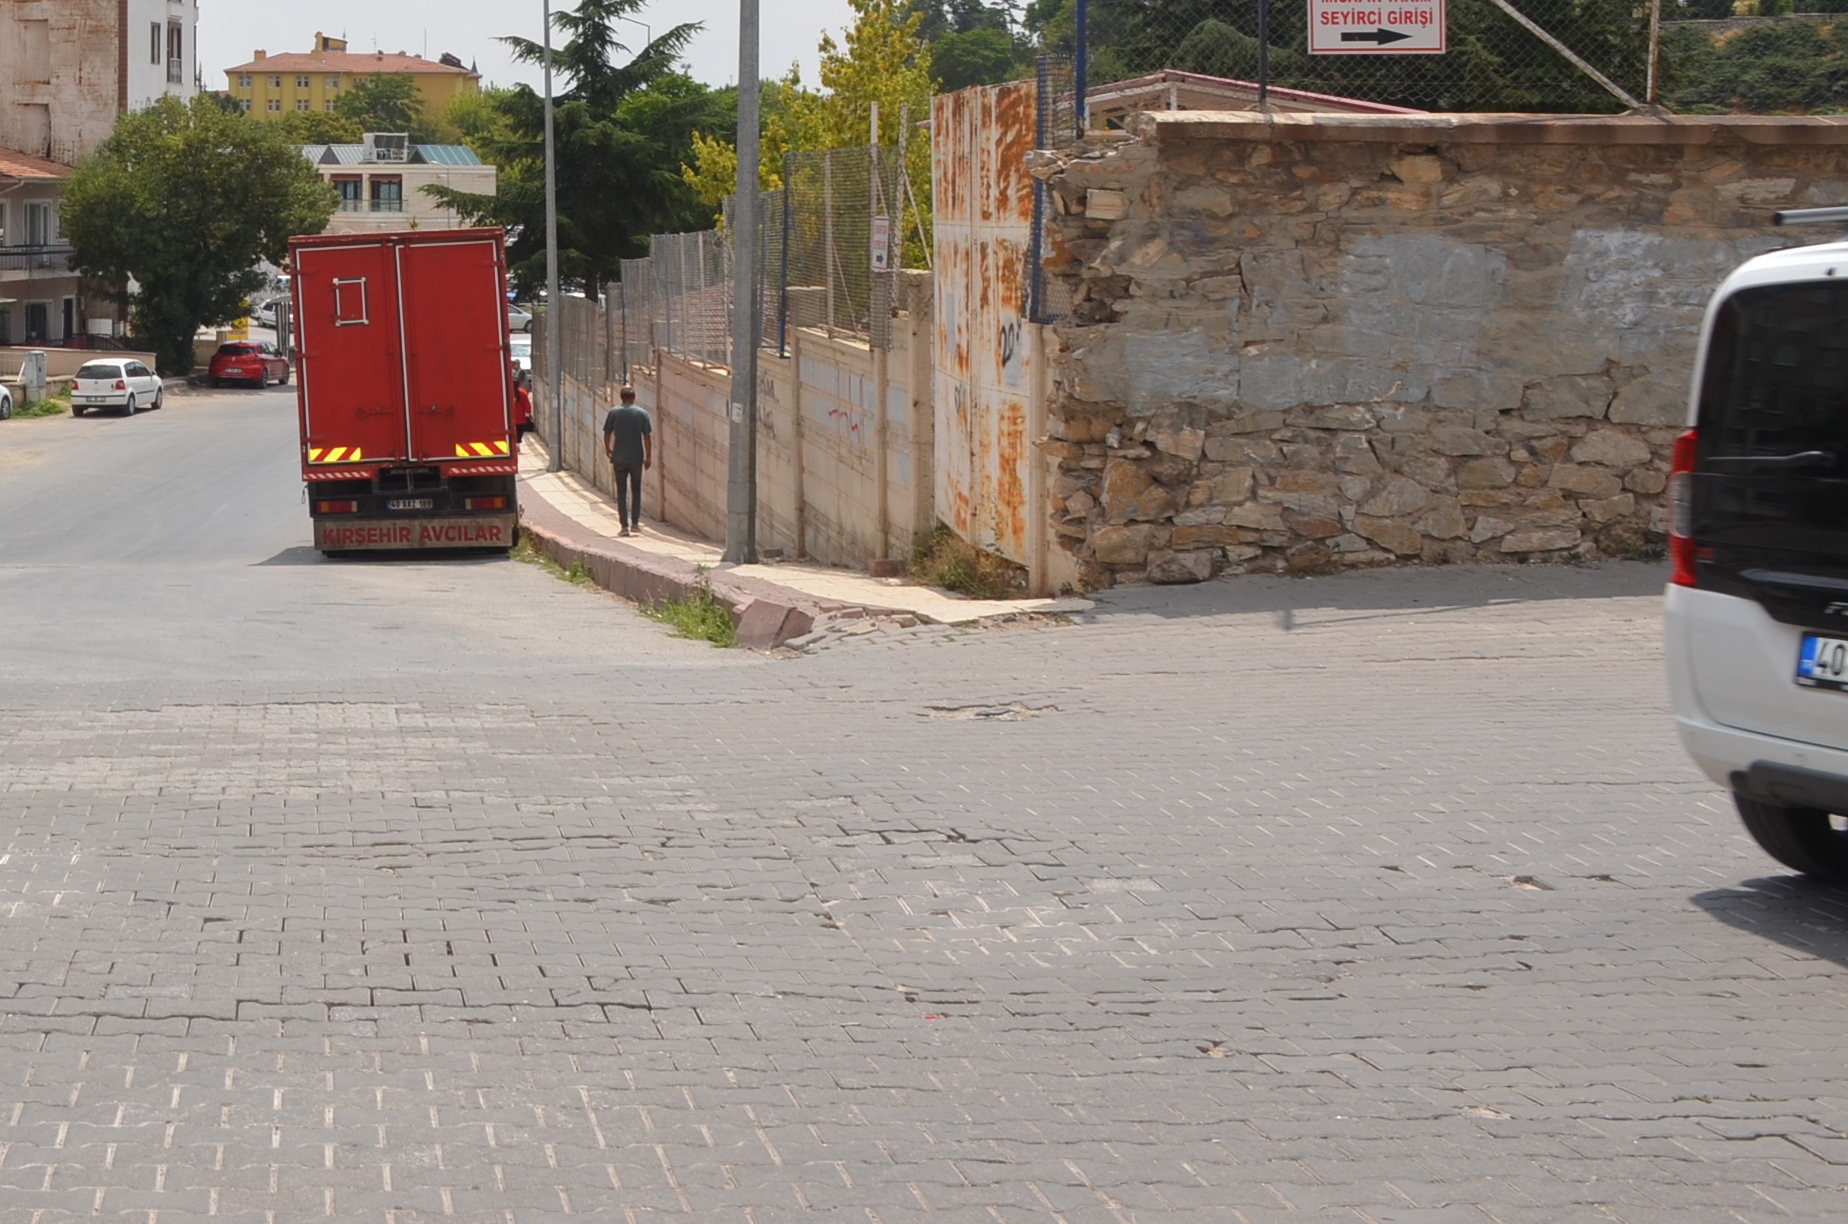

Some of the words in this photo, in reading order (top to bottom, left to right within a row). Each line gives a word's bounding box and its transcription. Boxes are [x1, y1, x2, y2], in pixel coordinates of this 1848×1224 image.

[1320, 7, 1382, 25] SEYİRCİ
[1387, 7, 1433, 28] GİRİŞİ
[322, 523, 412, 546] KIRŞEHİR
[419, 525, 502, 543] AVCILAR
[1815, 642, 1846, 676] 40
